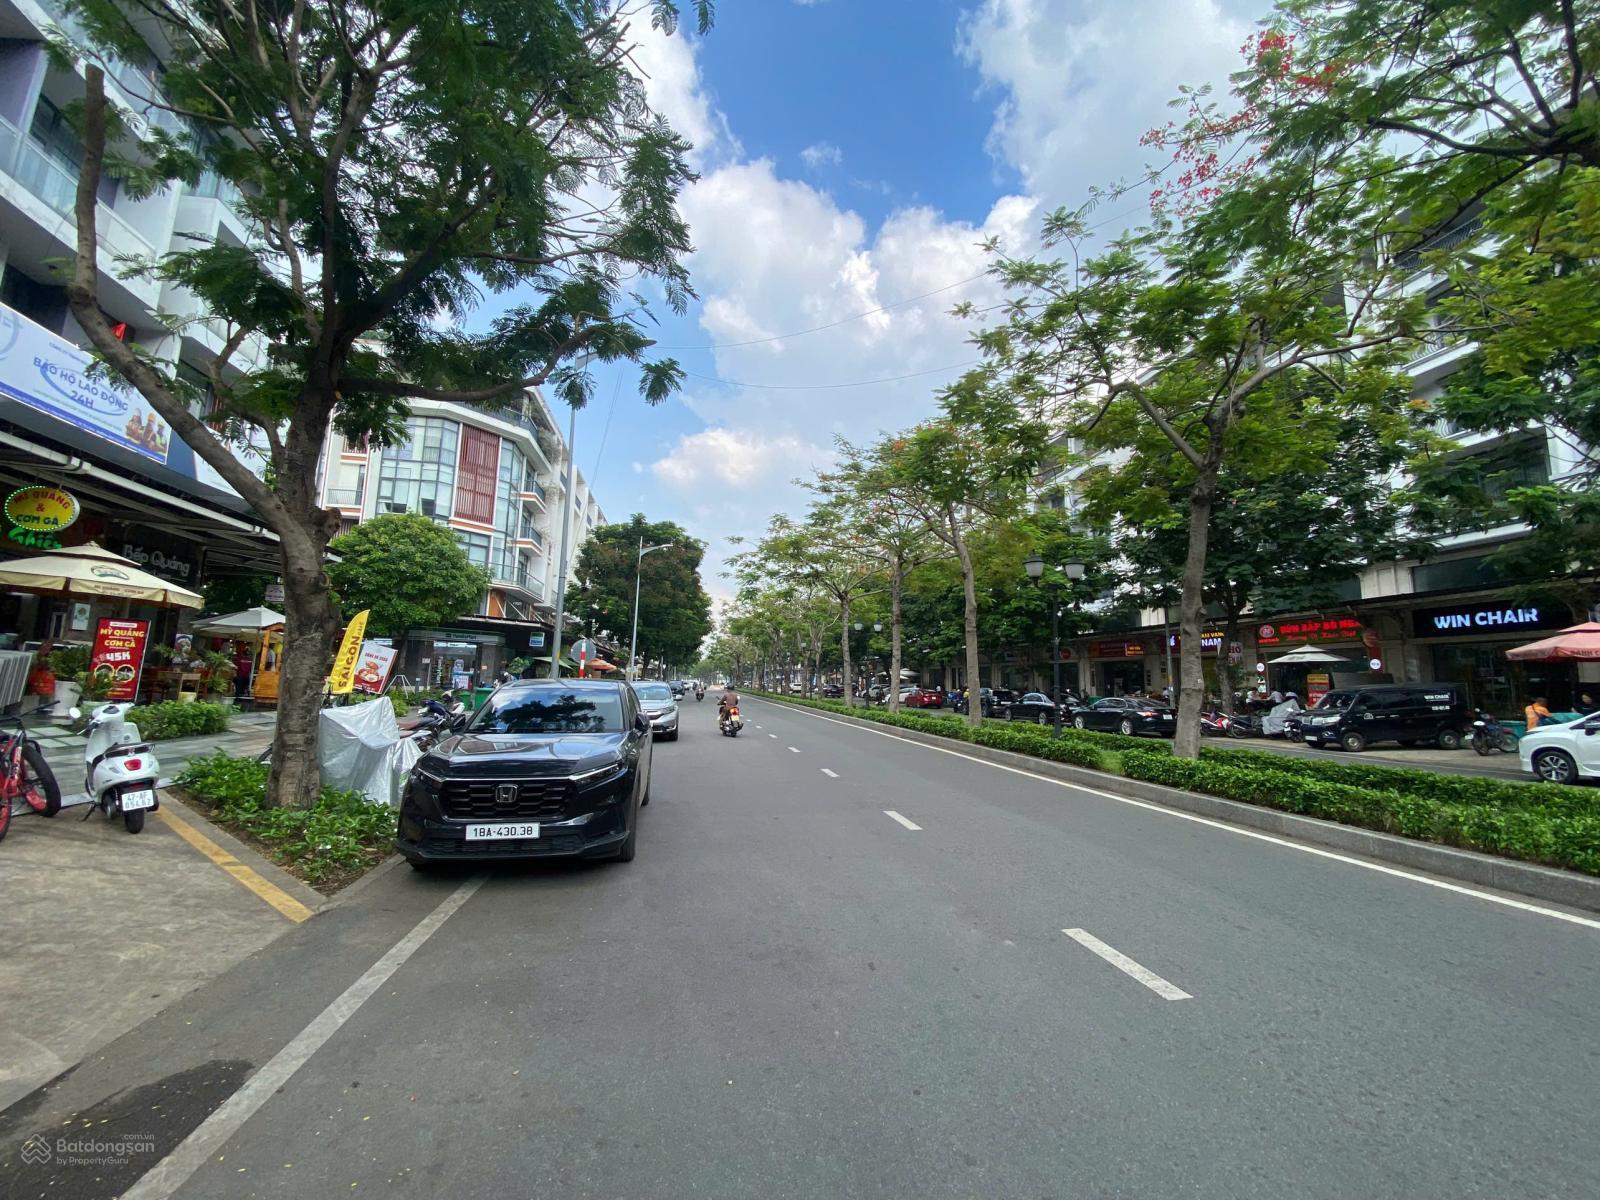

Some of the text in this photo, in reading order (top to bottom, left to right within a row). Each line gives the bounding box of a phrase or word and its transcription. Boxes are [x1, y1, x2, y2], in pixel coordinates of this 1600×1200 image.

[33, 357, 129, 411] BẢO HỘ LAO ĐỘNG
[71, 390, 94, 409] 24H
[123, 543, 149, 564] Bếp
[151, 550, 190, 577] Quảng
[1433, 607, 1538, 629] WIN CHAIR
[104, 640, 122, 648] CƠM
[106, 651, 131, 661] 45K
[338, 635, 361, 688] SAIGON
[473, 825, 533, 838] 18A-430.38
